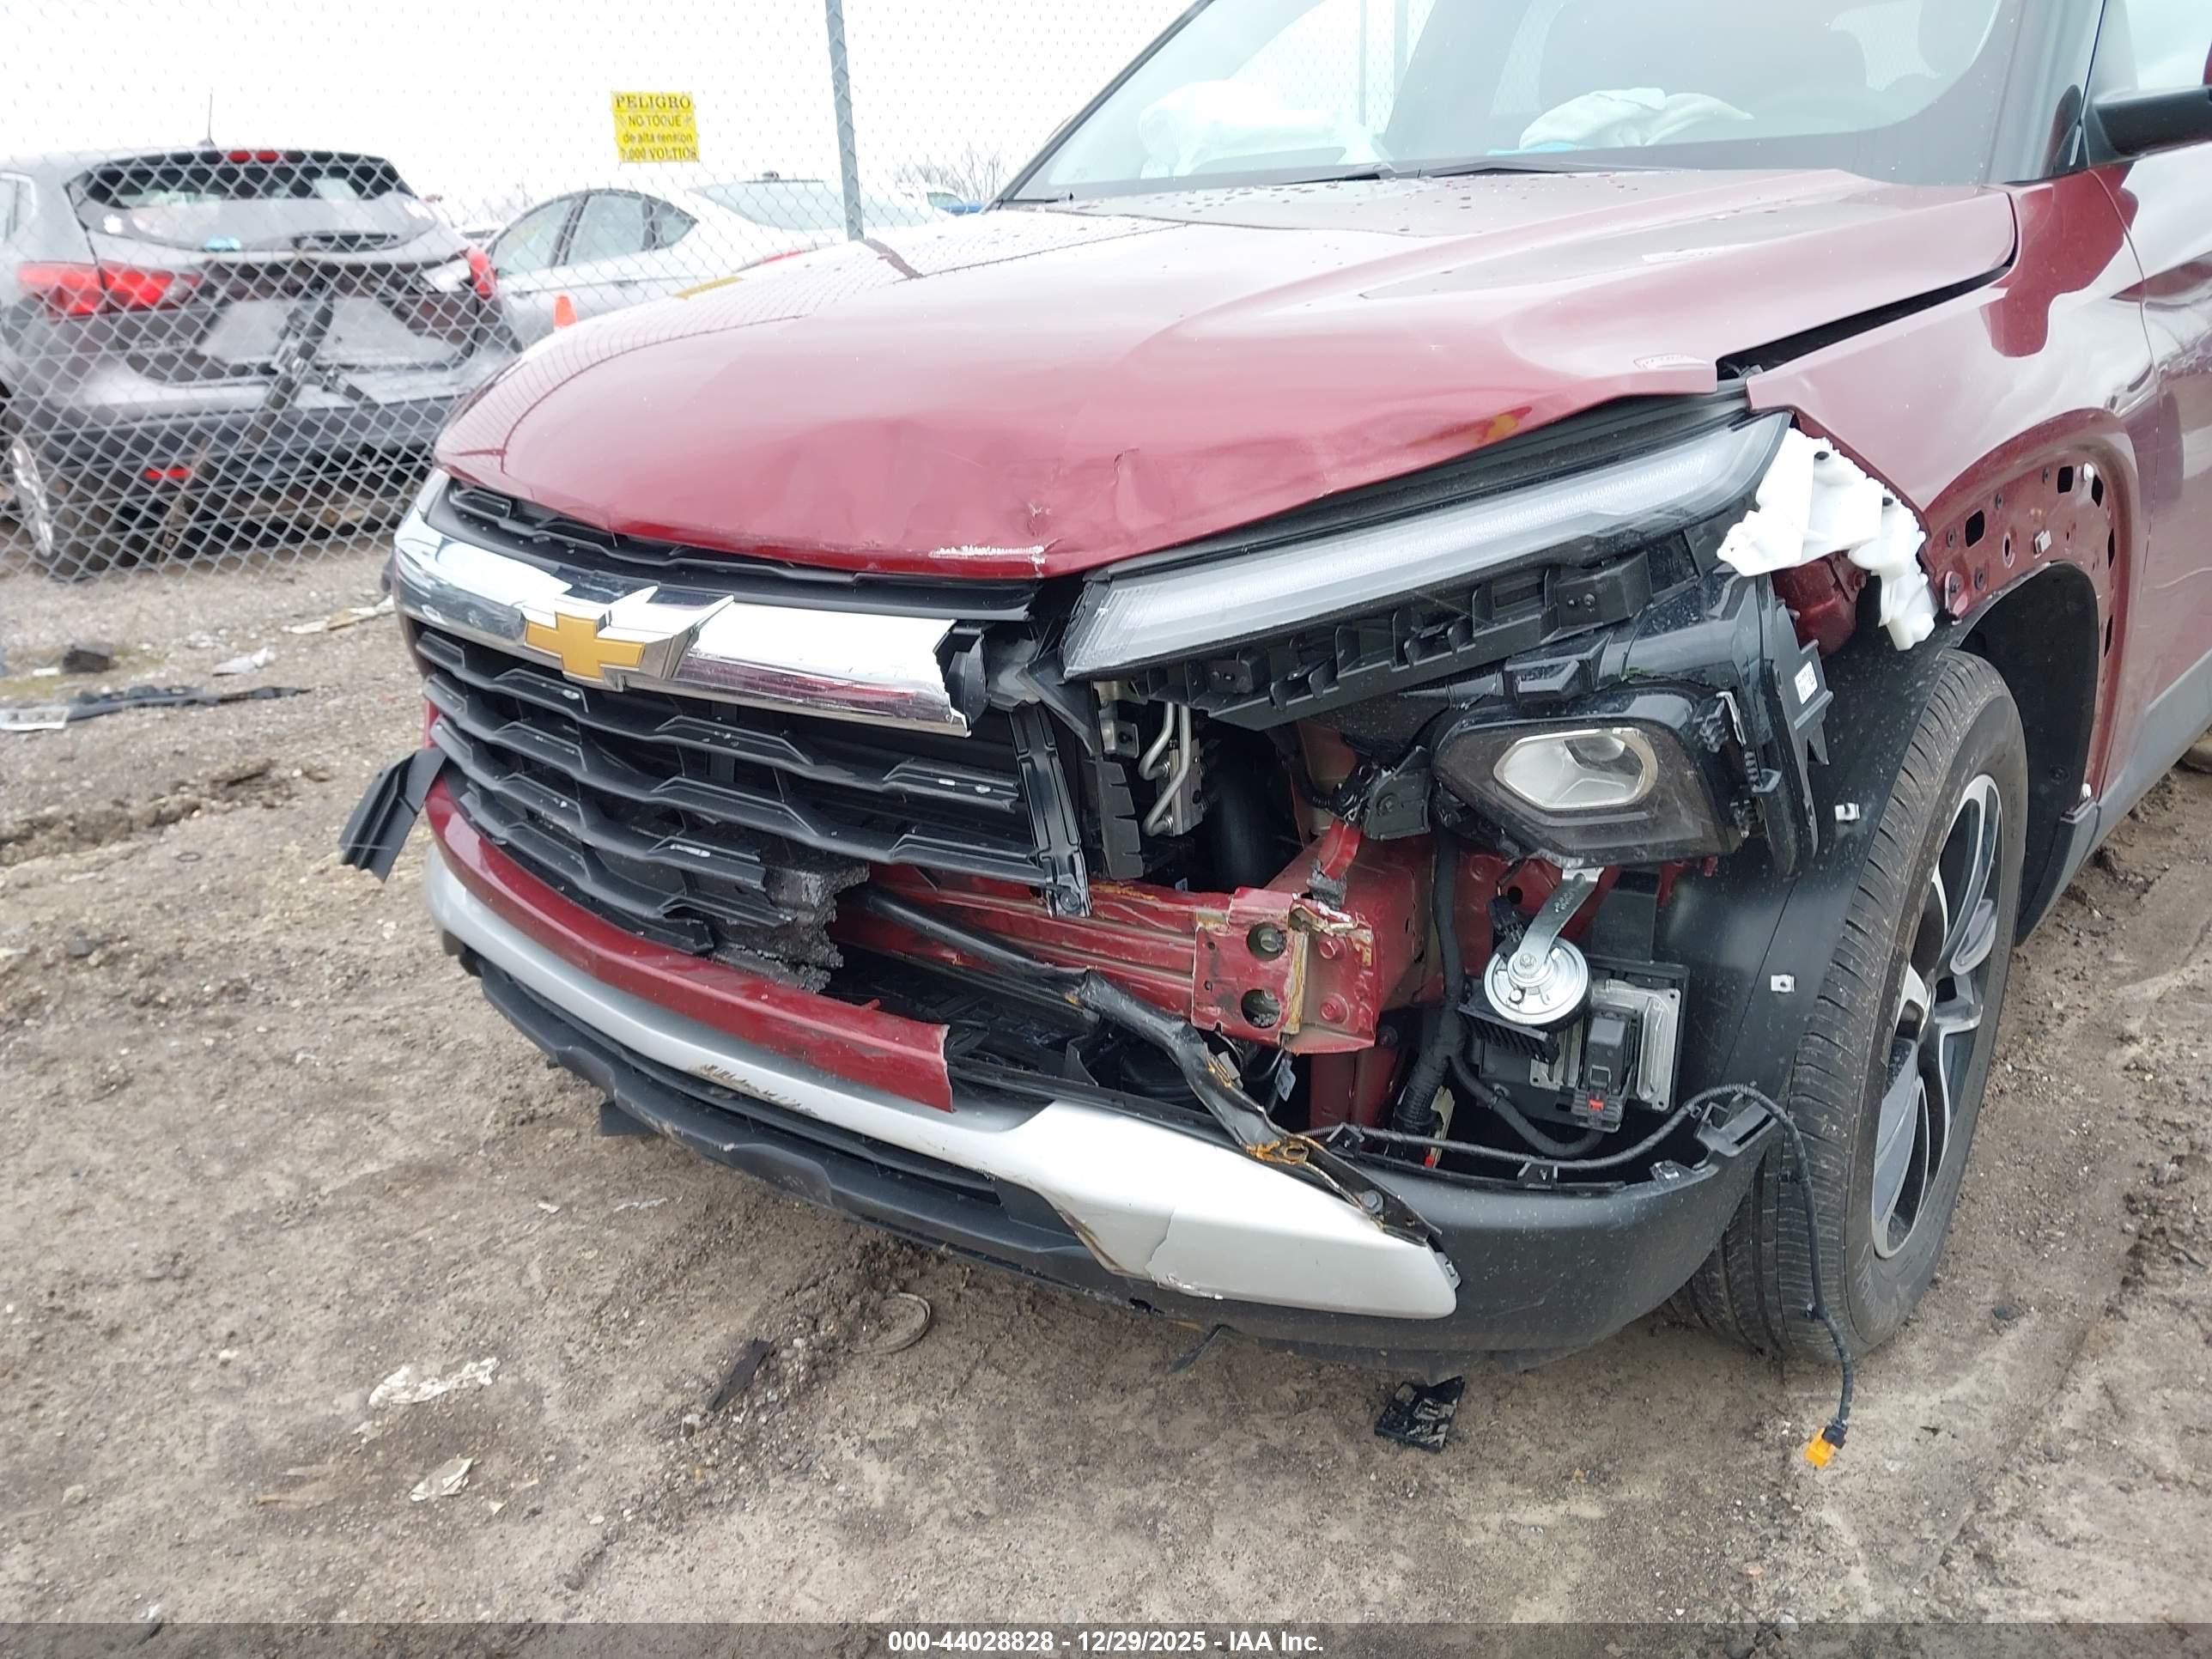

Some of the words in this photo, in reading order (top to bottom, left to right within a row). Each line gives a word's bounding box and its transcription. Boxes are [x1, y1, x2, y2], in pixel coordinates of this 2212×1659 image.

[616, 95, 691, 110] PELIGRO
[628, 115, 644, 127] NO
[646, 114, 682, 127] TOQUE
[649, 146, 697, 161] VOLTIOS
